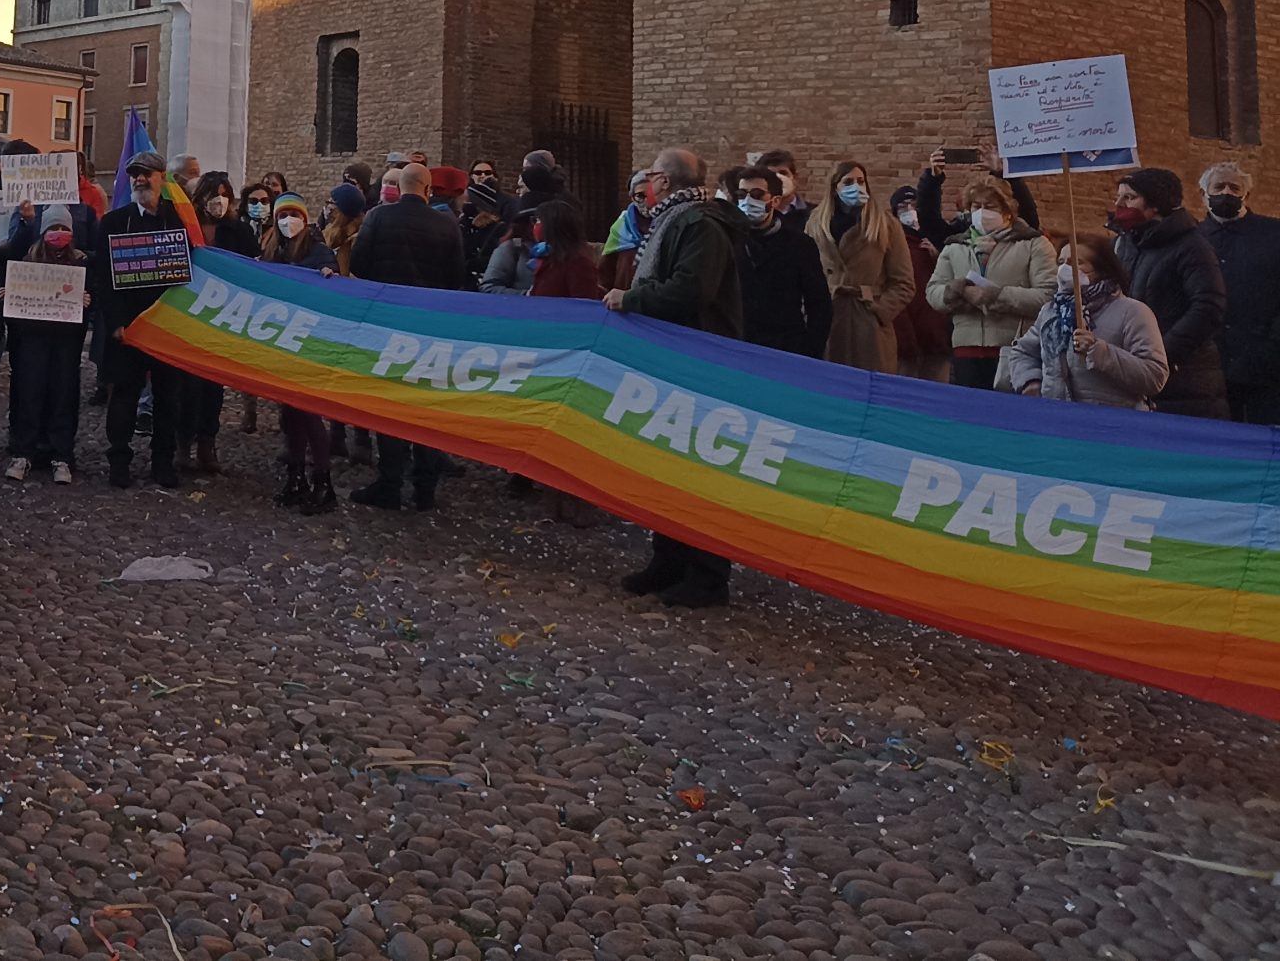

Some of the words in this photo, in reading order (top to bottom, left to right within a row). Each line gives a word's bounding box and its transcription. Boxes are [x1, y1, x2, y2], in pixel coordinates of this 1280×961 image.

[154, 232, 184, 244] NATO
[159, 269, 189, 280] PACE
[188, 277, 320, 353] PACE
[371, 333, 538, 393] PACE
[603, 372, 796, 486] PACE
[892, 457, 1166, 571] PACE
